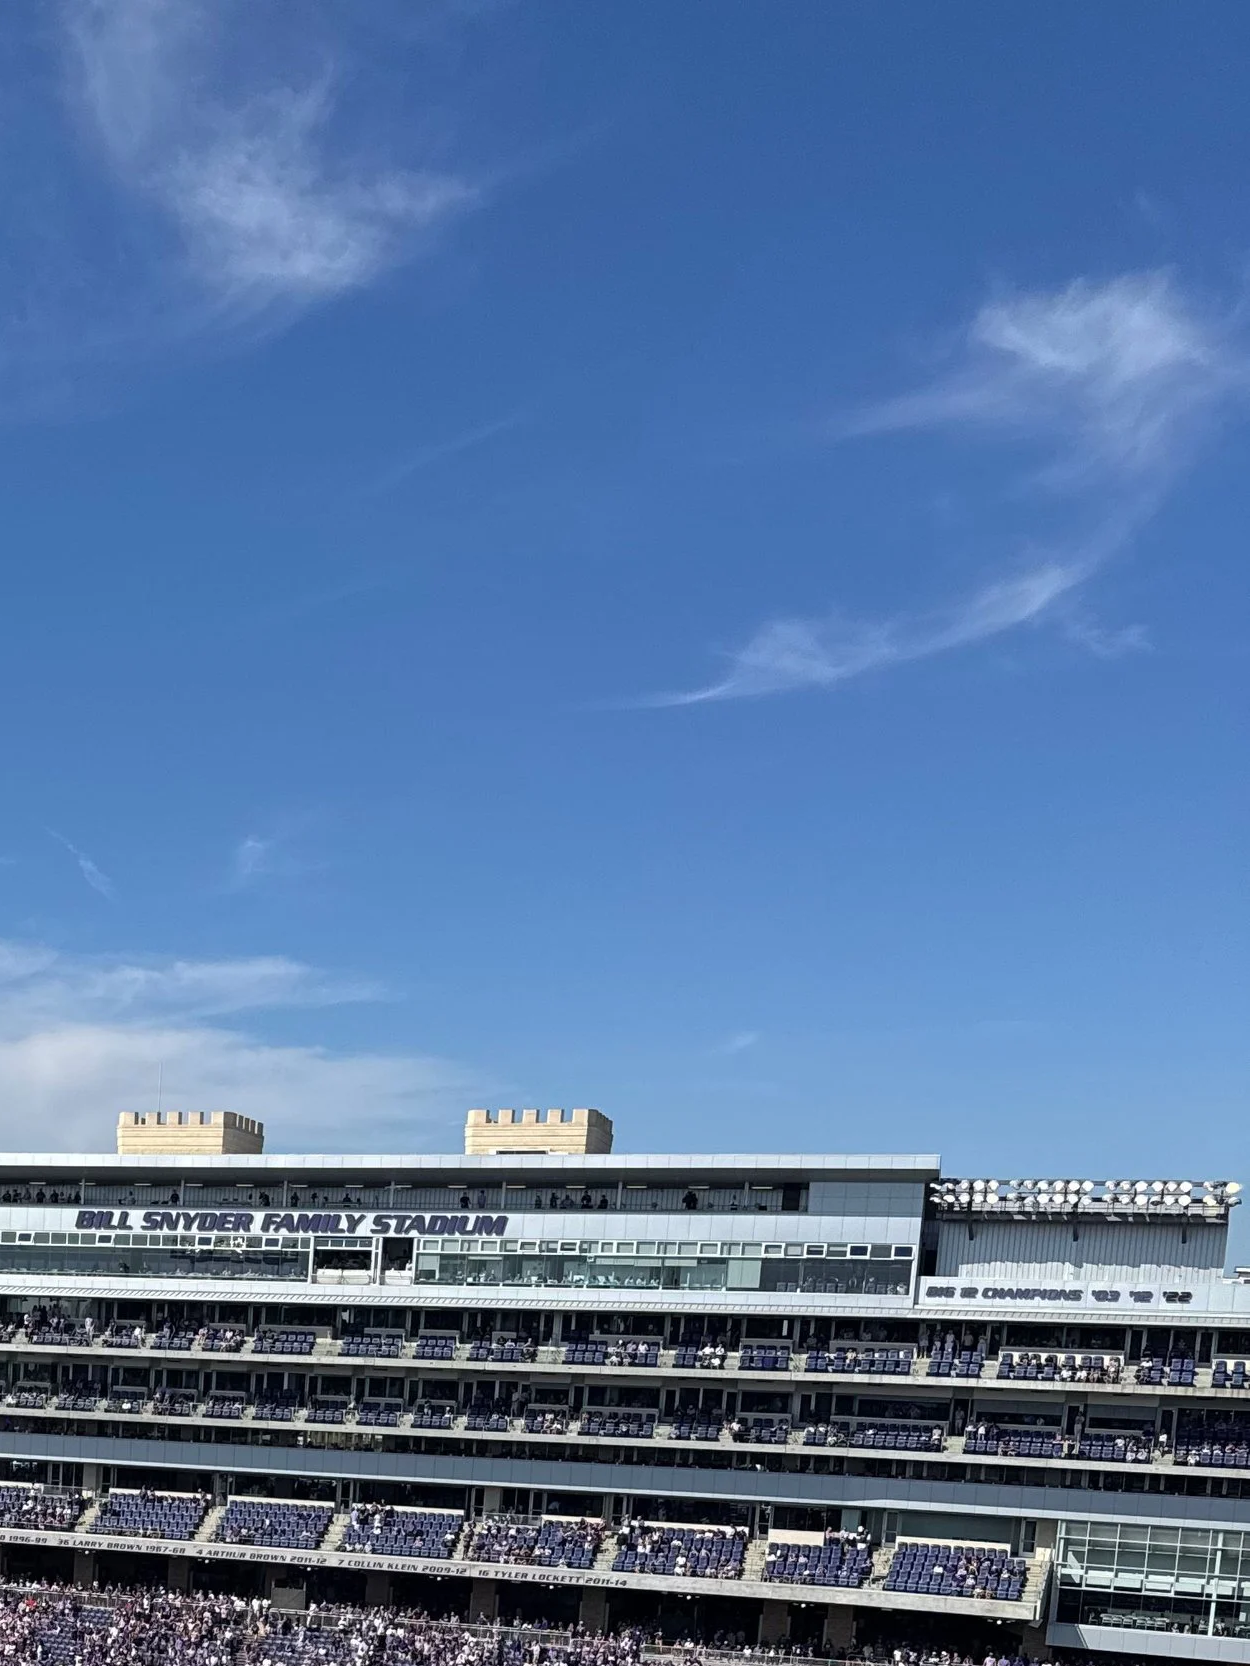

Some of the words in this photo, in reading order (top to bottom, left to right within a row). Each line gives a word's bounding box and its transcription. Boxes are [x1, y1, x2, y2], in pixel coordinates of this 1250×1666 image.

[75, 1210, 133, 1231] BILL
[141, 1211, 253, 1233] SNYDER
[261, 1212, 367, 1234] FAMILY
[371, 1213, 509, 1236] STADIUM
[925, 1286, 956, 1299] BIG
[959, 1287, 978, 1299] 12
[981, 1287, 1084, 1302] CHAMPIONS
[1092, 1289, 1120, 1303] '03
[1162, 1291, 1193, 1305] '22
[57, 1539, 70, 1547] 36
[72, 1539, 104, 1549] LARRY
[106, 1542, 142, 1552] BROWN
[196, 1548, 203, 1556] 4
[204, 1549, 246, 1559] ARTHUR
[249, 1552, 287, 1562] BROWN
[289, 1555, 328, 1565] 2011-12
[337, 1559, 345, 1567] 7
[347, 1559, 384, 1570] COLLIN
[387, 1562, 419, 1573] KLEIN
[421, 1565, 467, 1575] 2009-12
[478, 1569, 489, 1577] 16
[493, 1570, 529, 1580] TYLER
[531, 1573, 583, 1584] LOCKETT
[584, 1577, 627, 1588] 2011-14
